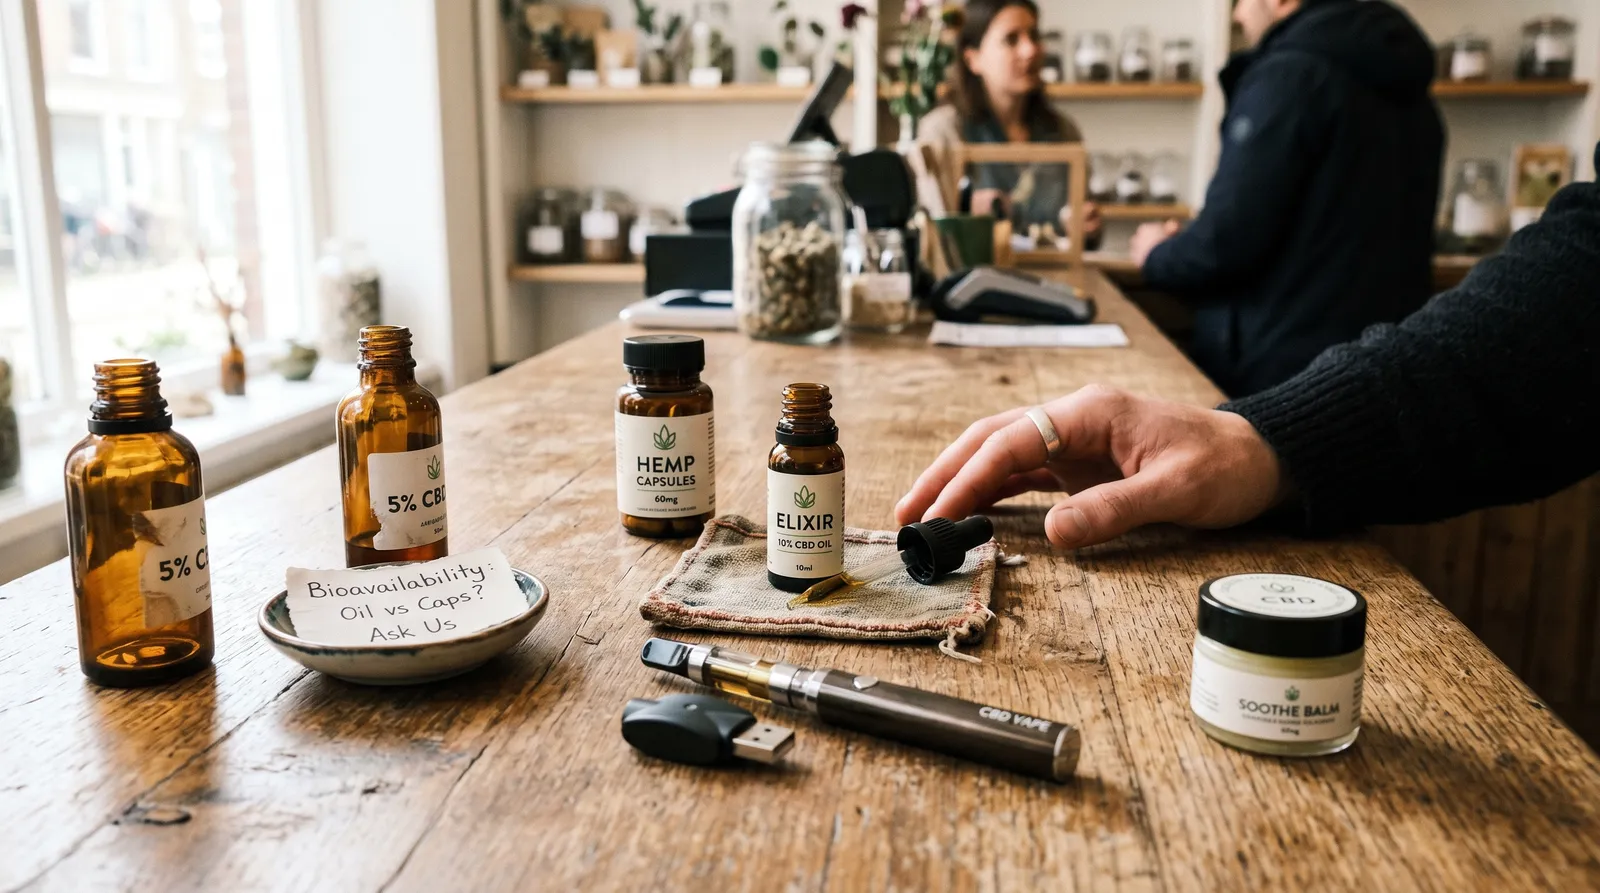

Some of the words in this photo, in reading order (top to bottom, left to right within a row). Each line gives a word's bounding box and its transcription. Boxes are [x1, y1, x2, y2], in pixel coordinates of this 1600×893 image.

[637, 455, 695, 473] HEMP
[636, 475, 696, 487] CAPSULES
[388, 494, 417, 513] 5%
[422, 484, 447, 508] CBD
[654, 495, 678, 505] 60mg
[776, 512, 833, 531] ELIXIR
[778, 538, 793, 549] 10%
[794, 540, 815, 550] CBD
[817, 540, 832, 549] OIL
[159, 555, 191, 581] 5%
[307, 562, 494, 598] Bioavailability:
[340, 604, 373, 621] Oil
[384, 603, 409, 617] vs
[418, 584, 484, 611] Caps?
[1261, 596, 1315, 605] CBD
[370, 625, 416, 643] Ask
[423, 617, 457, 633] Us
[1239, 699, 1299, 717] SOOTHE
[1304, 703, 1340, 717] BALM
[979, 706, 1012, 722] CBD
[1013, 714, 1052, 733] VAPE
